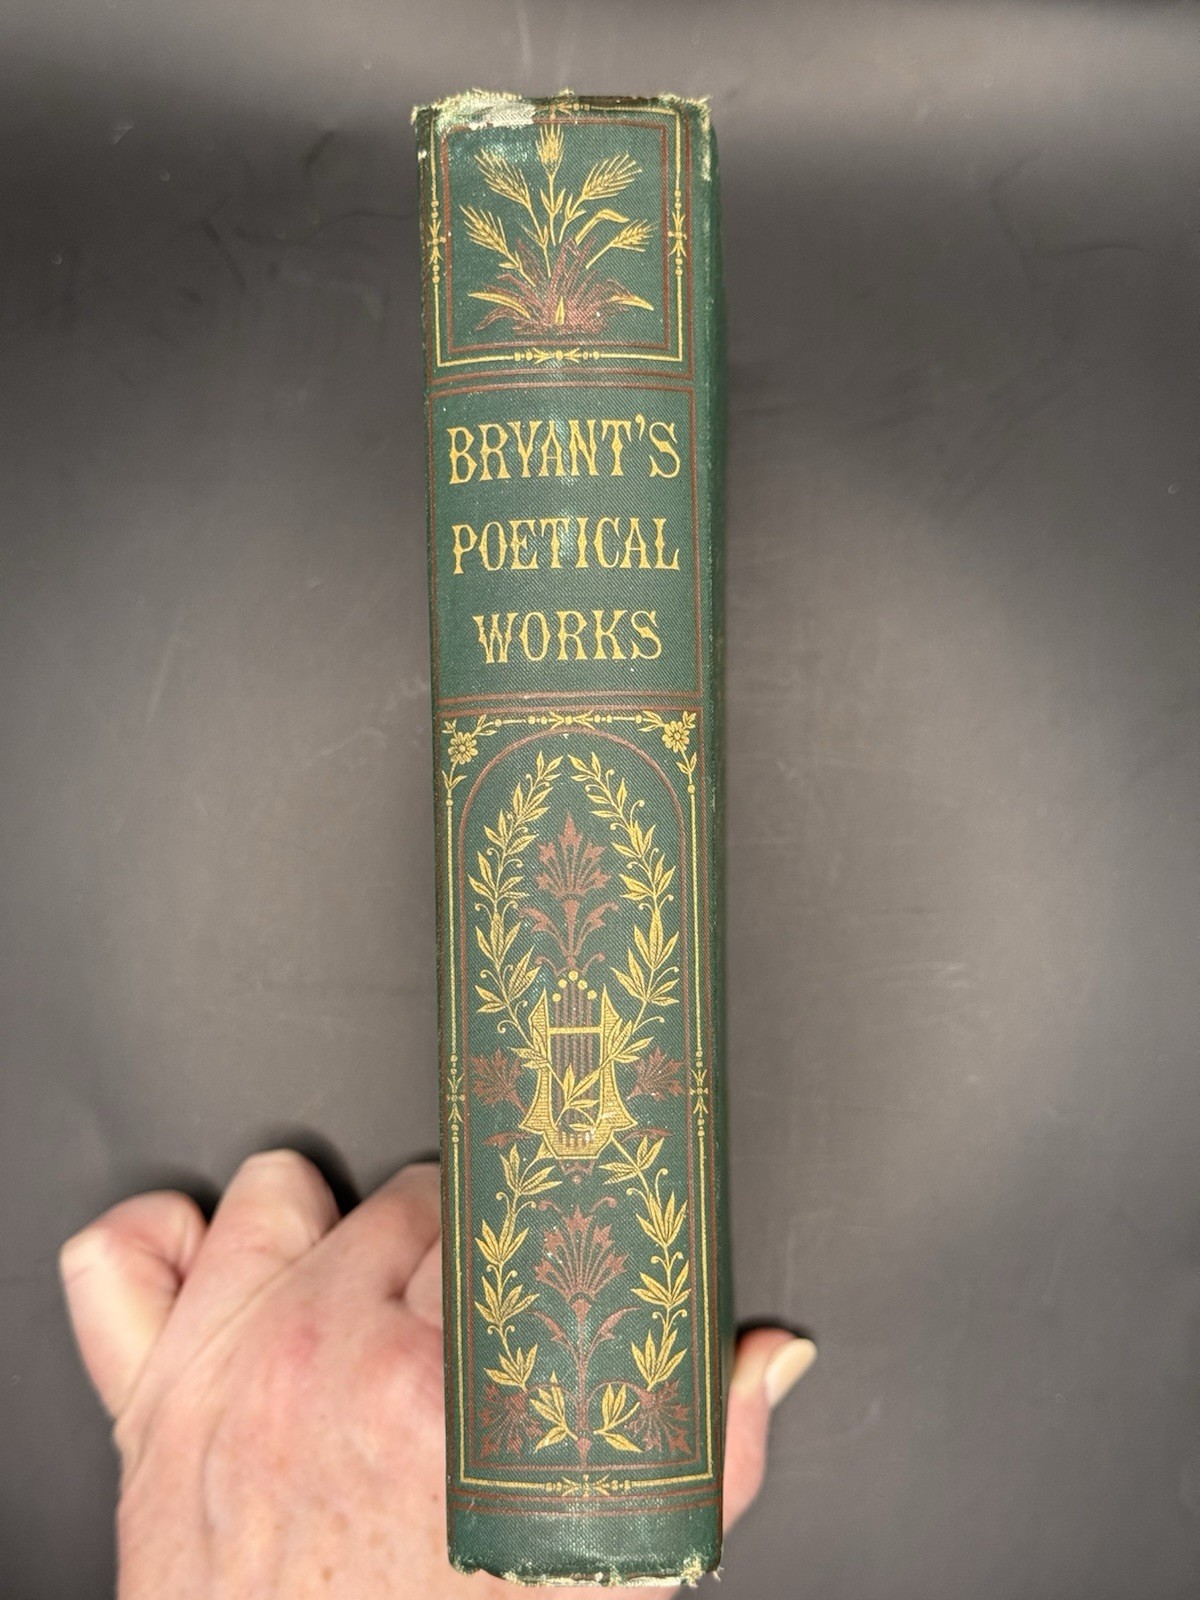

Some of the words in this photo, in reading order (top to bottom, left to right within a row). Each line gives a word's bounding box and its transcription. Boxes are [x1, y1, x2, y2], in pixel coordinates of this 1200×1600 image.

[446, 413, 681, 485] BRYANT'S
[451, 517, 680, 575] POETICAL
[472, 609, 662, 664] WORKS
